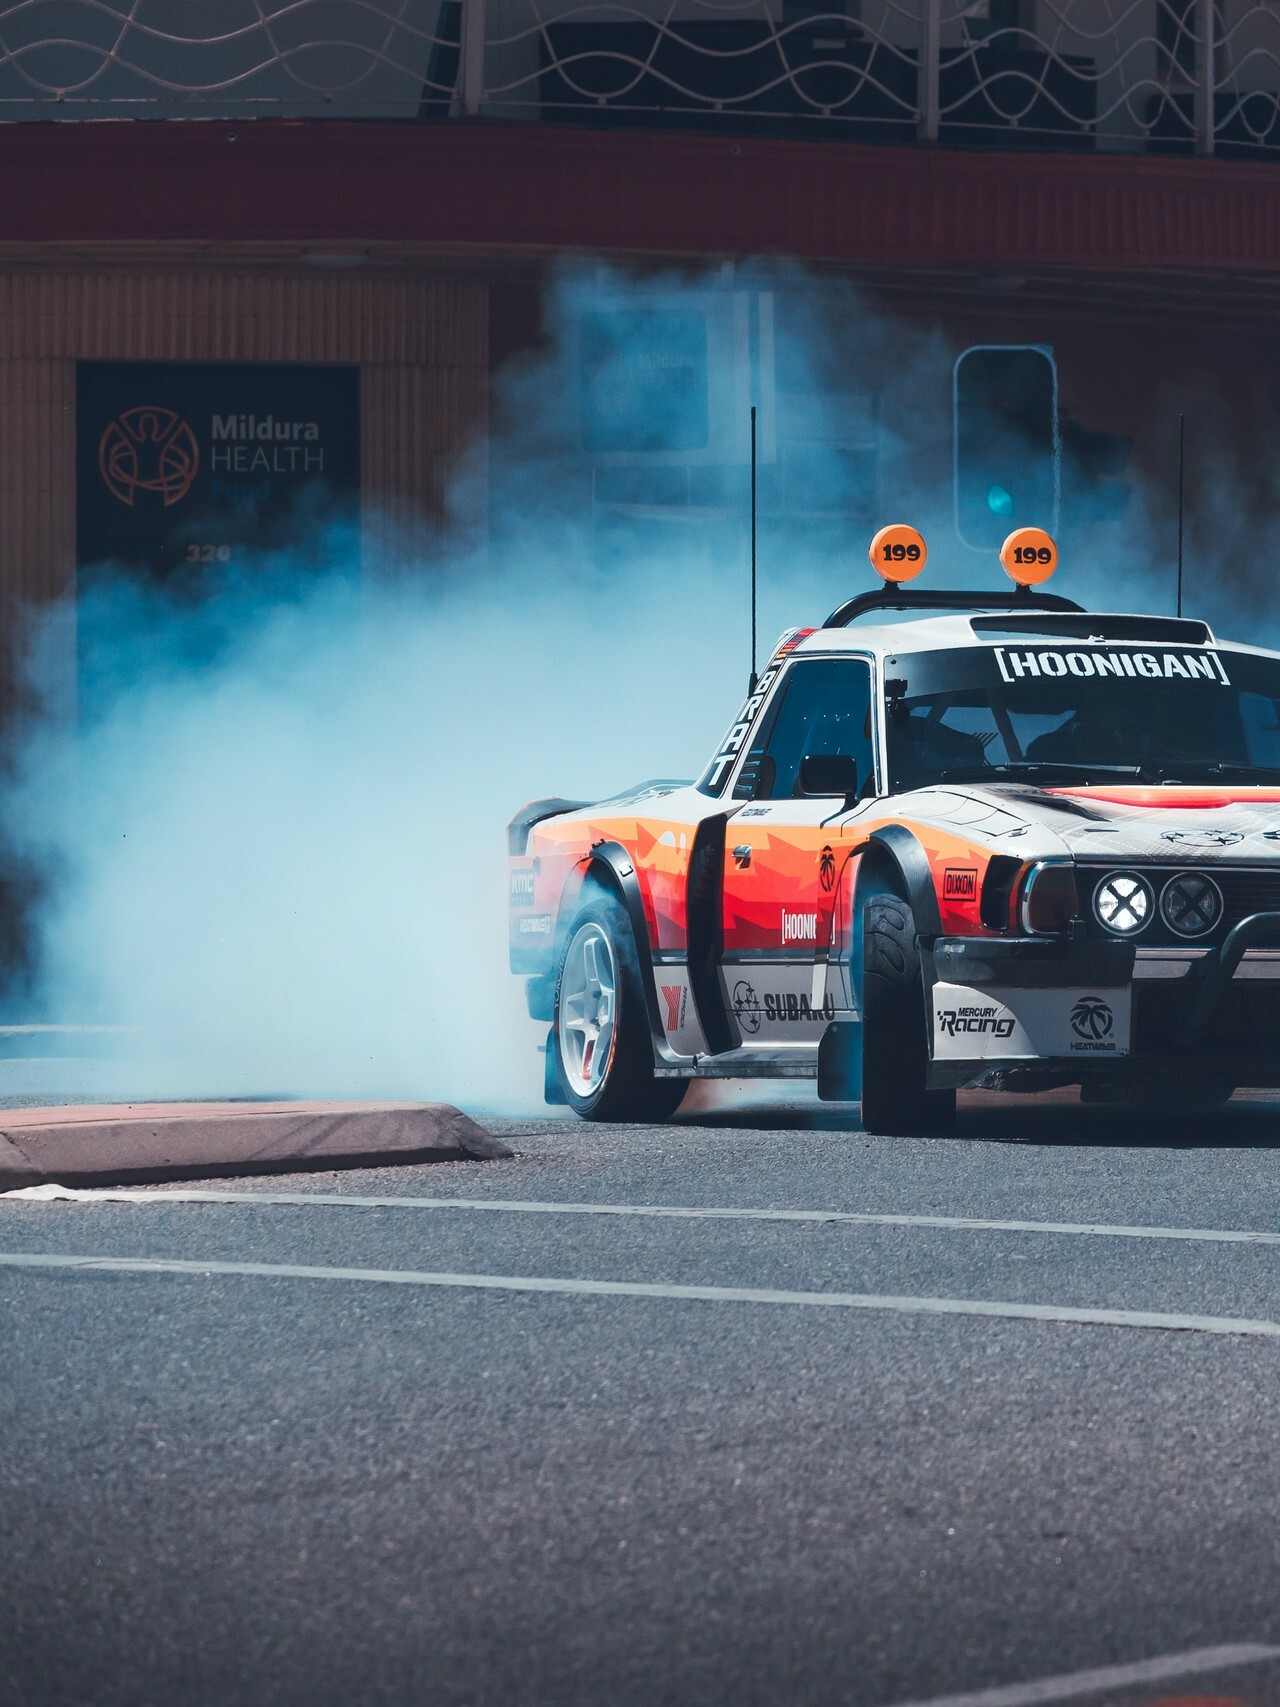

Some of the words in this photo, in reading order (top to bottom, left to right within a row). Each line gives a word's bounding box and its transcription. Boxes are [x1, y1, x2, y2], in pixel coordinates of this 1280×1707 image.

[211, 414, 320, 441] Mildura
[211, 446, 324, 472] HEALTH
[186, 544, 231, 563] 320
[883, 544, 921, 561] 199
[1013, 547, 1052, 564] 199
[709, 670, 777, 786] BRAT
[946, 874, 974, 894] DIXXON
[958, 1007, 998, 1018] MERCURY
[939, 1010, 1016, 1038] Racing
